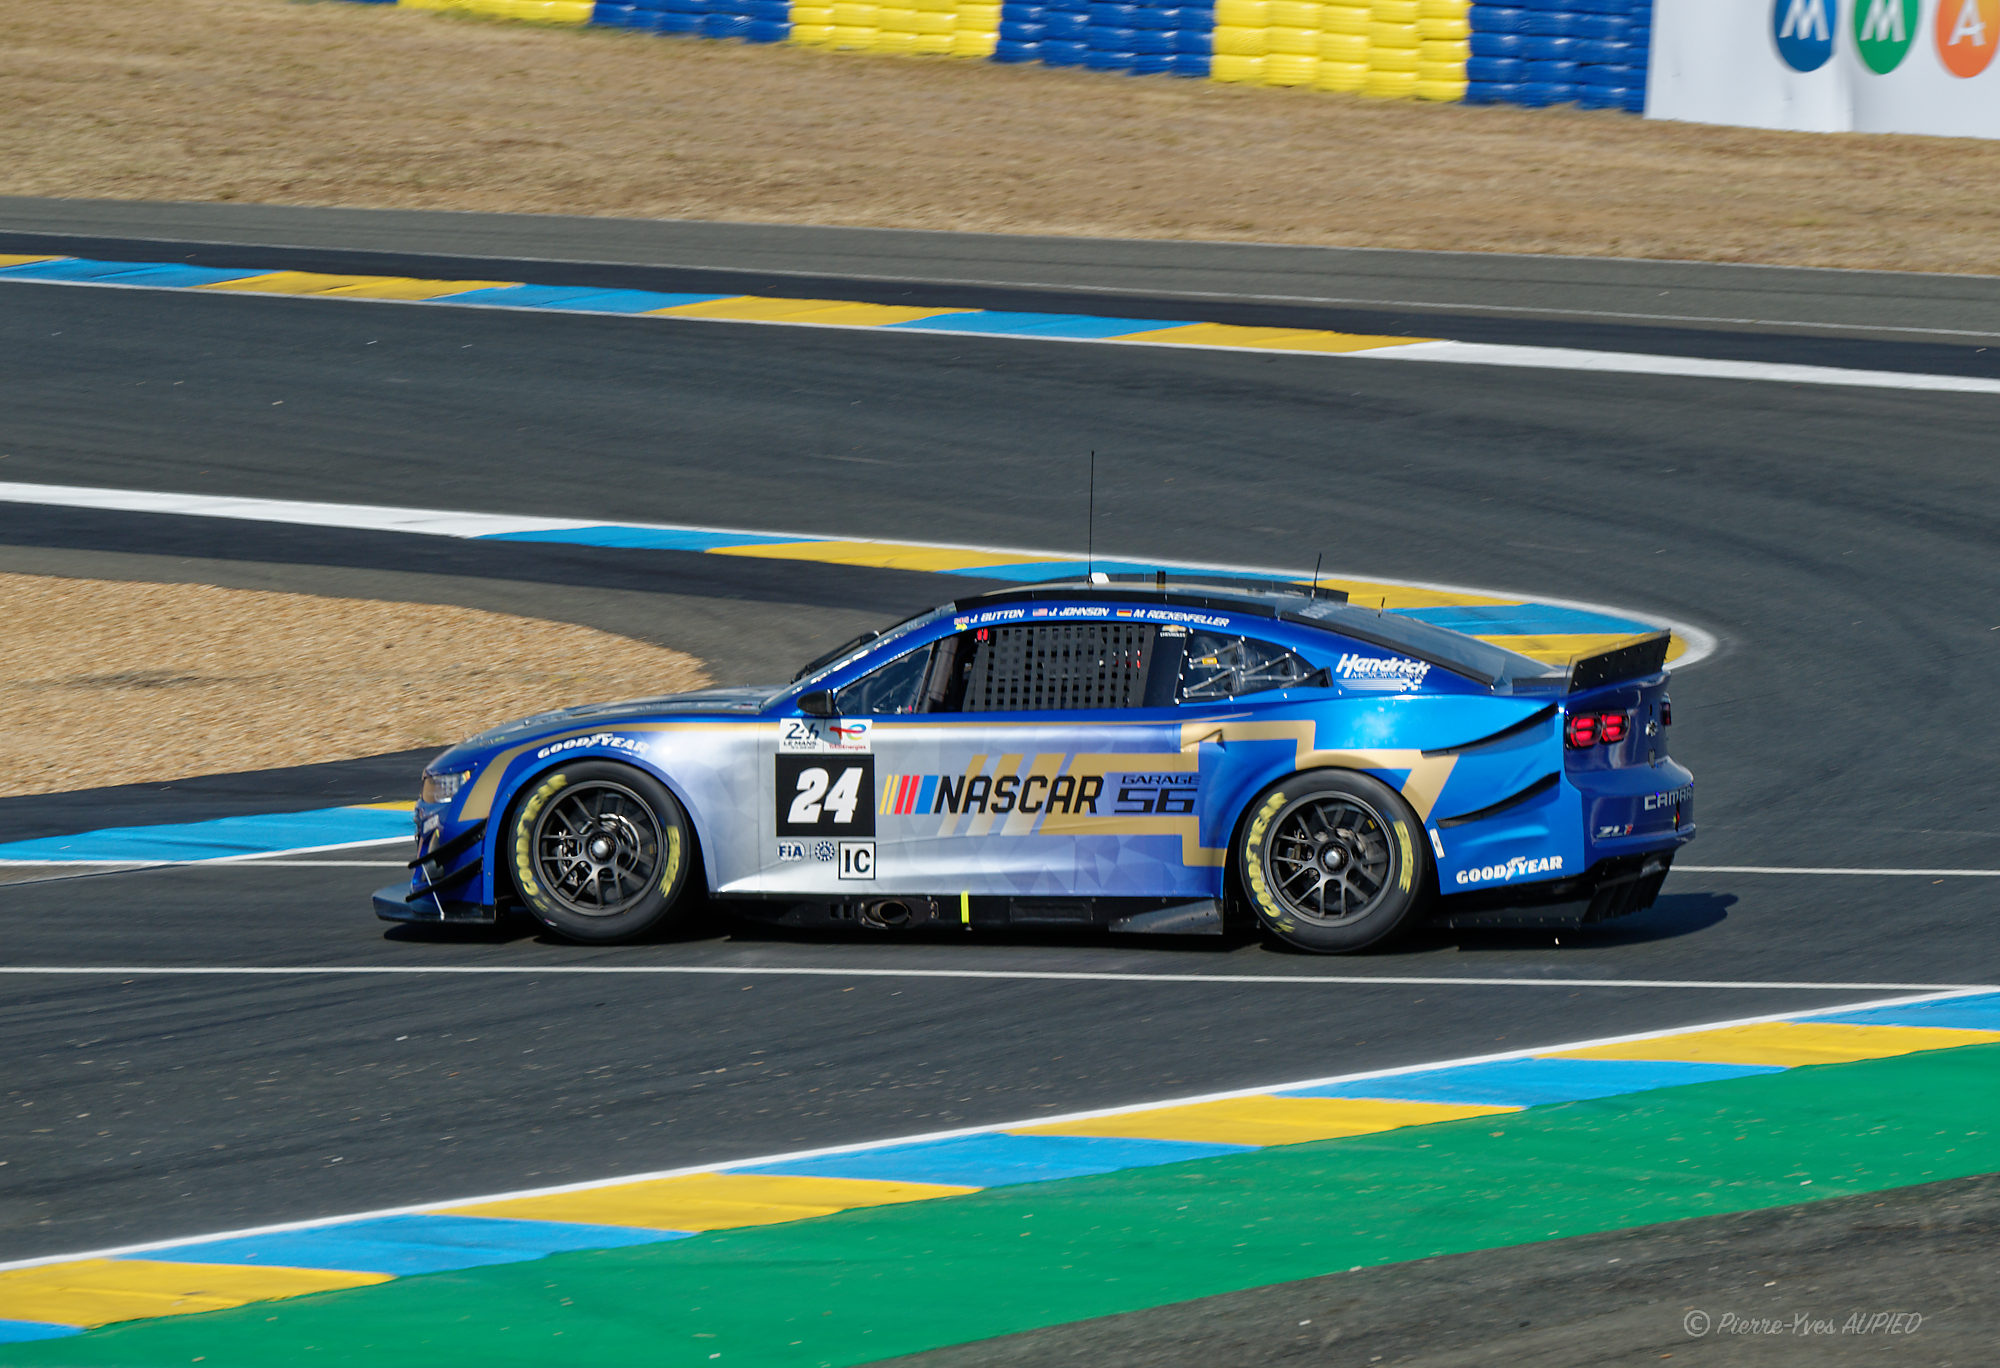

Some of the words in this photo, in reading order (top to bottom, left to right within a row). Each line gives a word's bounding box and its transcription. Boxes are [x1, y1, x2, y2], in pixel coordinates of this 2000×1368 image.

[980, 608, 1026, 623] BUTTON
[1059, 606, 1111, 617] JOHNSON
[1146, 609, 1230, 628] ROCKENFELLER
[1335, 653, 1432, 679] Hendrick
[537, 733, 651, 759] GOODYEAR
[1121, 775, 1199, 785] GARAGE
[787, 767, 864, 824] 24
[933, 775, 1105, 815] NASCAR
[1114, 788, 1198, 814] 56
[1644, 787, 1693, 811] CAMAR
[844, 849, 871, 874] IC
[1456, 855, 1563, 884] GOODYEAR
